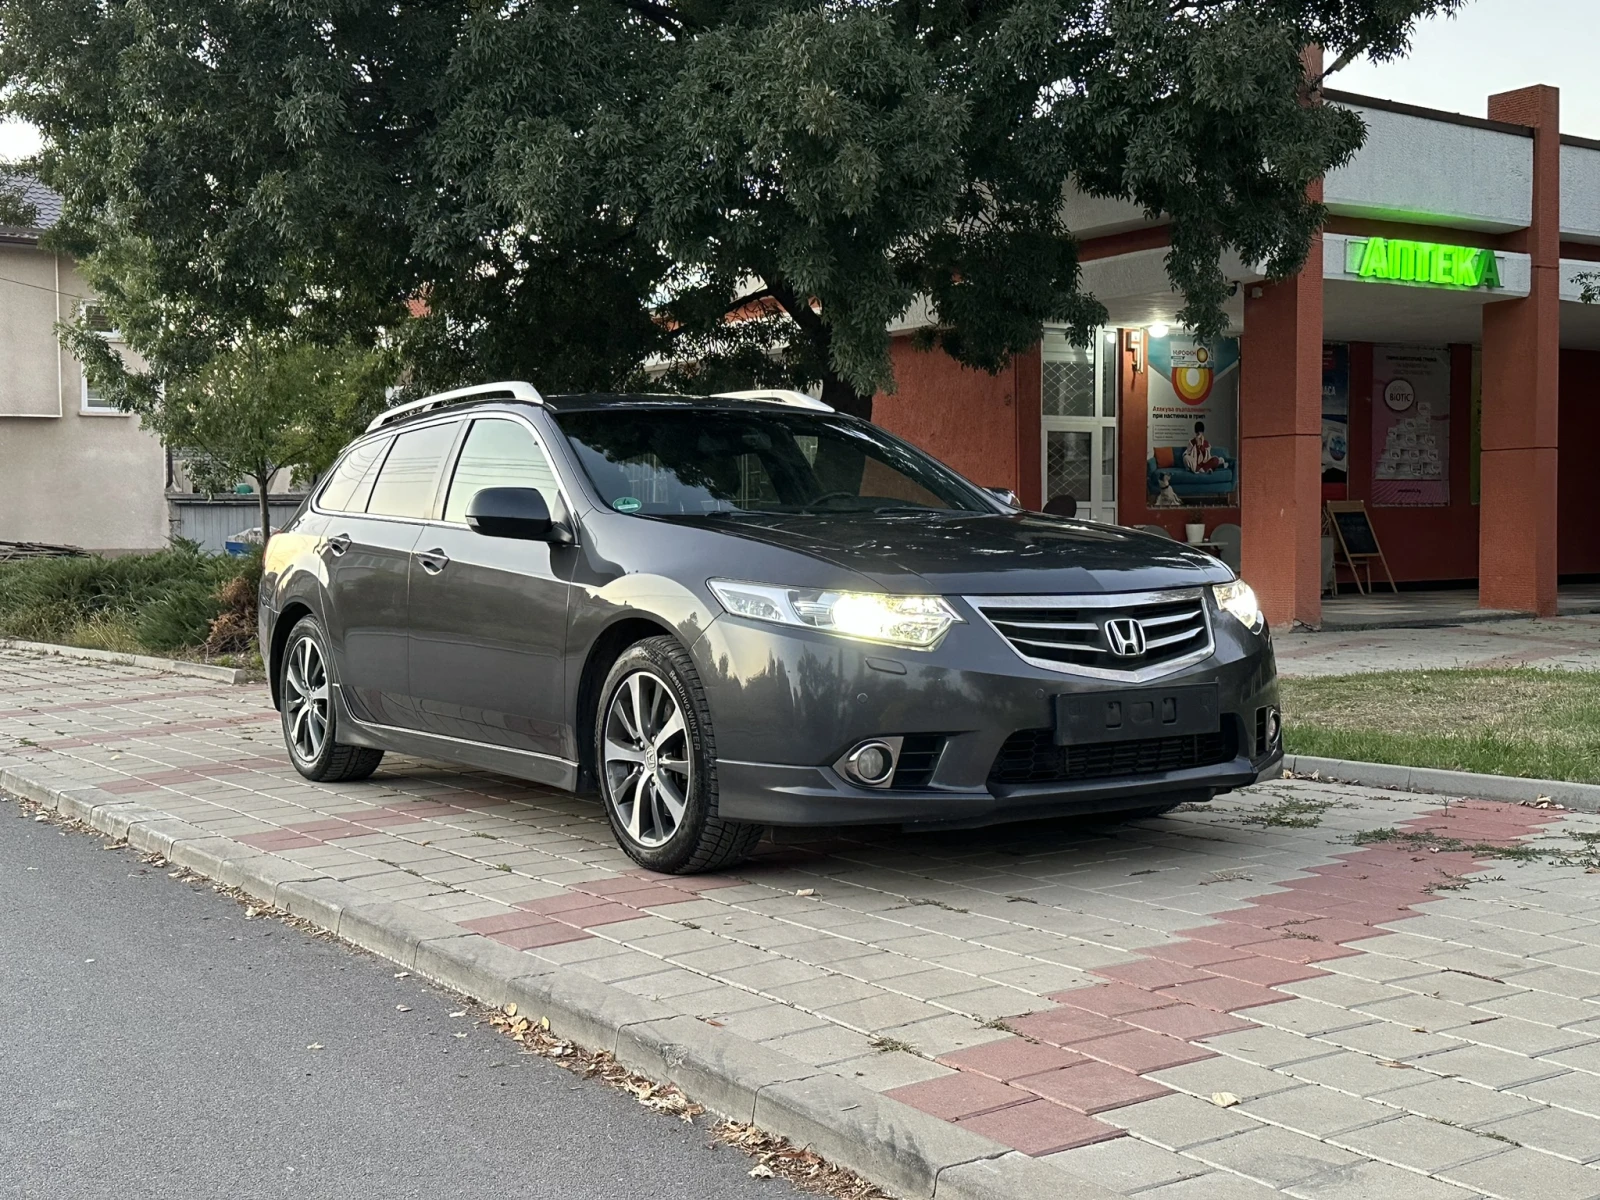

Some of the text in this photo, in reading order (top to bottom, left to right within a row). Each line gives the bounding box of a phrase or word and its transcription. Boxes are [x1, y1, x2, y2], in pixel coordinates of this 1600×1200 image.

[1358, 236, 1501, 288] АПТЕКА
[668, 669, 701, 751] BestDrive WINTER
